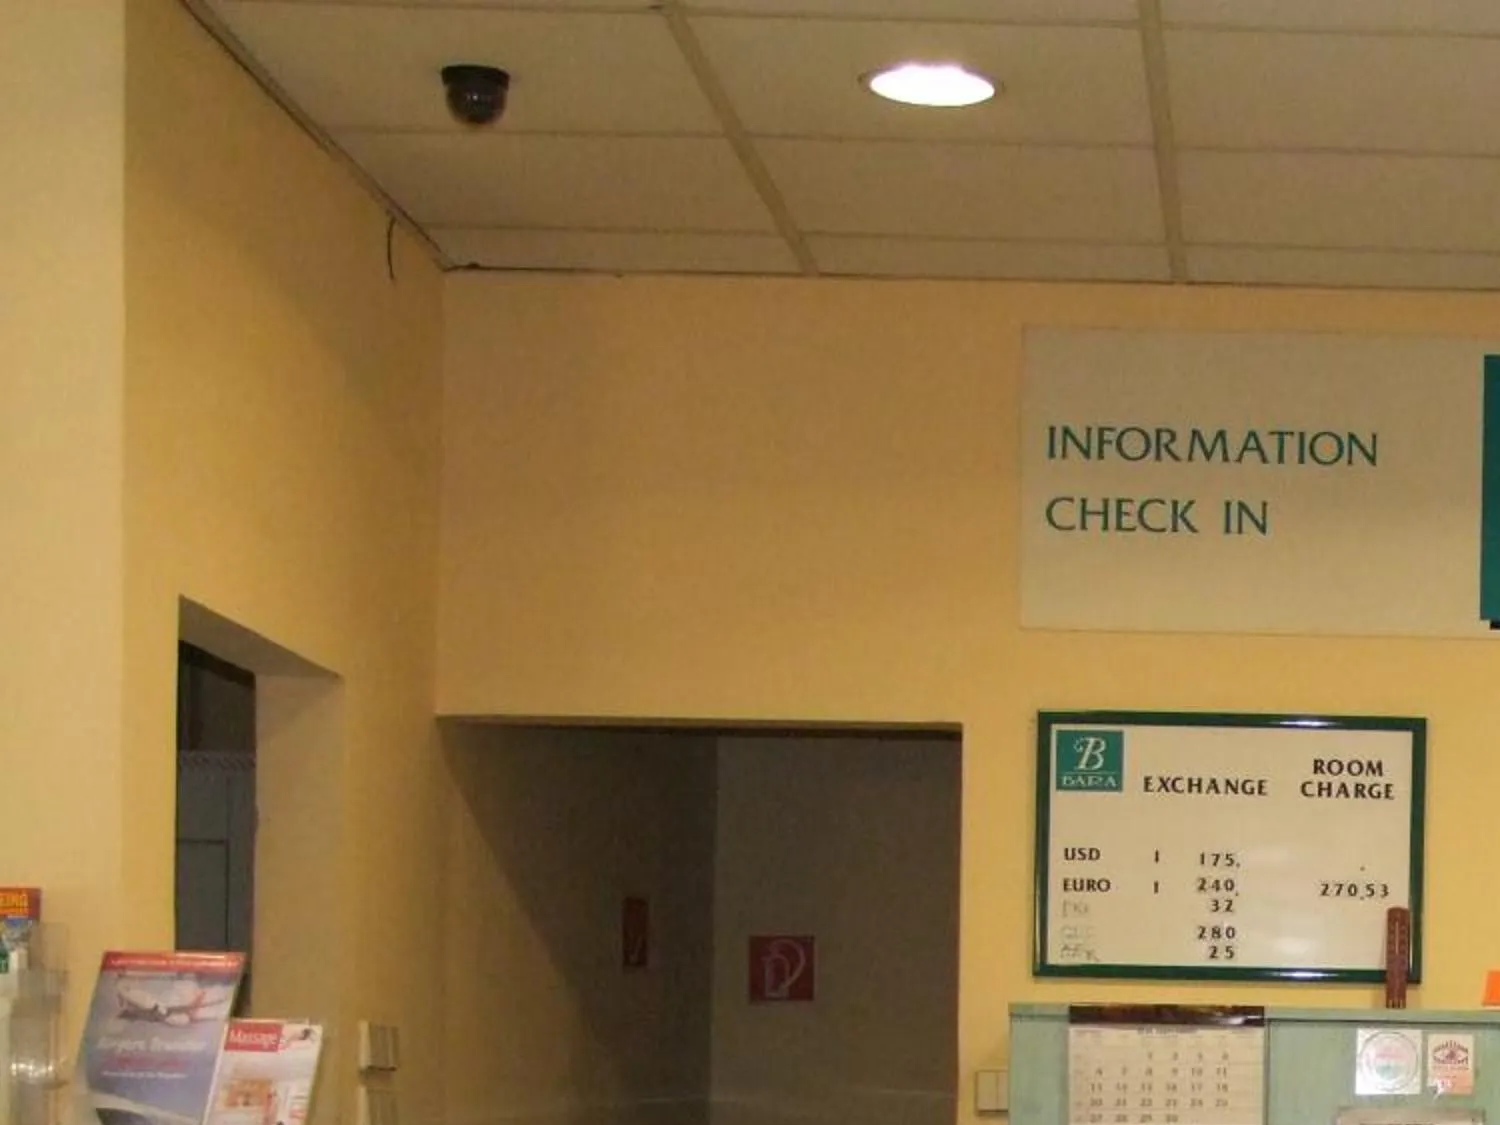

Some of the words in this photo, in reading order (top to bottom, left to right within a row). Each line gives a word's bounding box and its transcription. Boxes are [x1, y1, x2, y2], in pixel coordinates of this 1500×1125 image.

[1047, 425, 1378, 468] INFORMATION
[1045, 496, 1200, 534] CHECK
[1223, 499, 1269, 537] IN
[1312, 758, 1384, 778] ROOM
[1142, 776, 1268, 797] EXCHANGE
[1299, 780, 1395, 800] CHARGE
[1063, 846, 1102, 862] USD
[1062, 878, 1112, 894] EURO
[1210, 899, 1235, 914] 32
[1197, 925, 1237, 940] 280
[1208, 945, 1236, 960] 25
